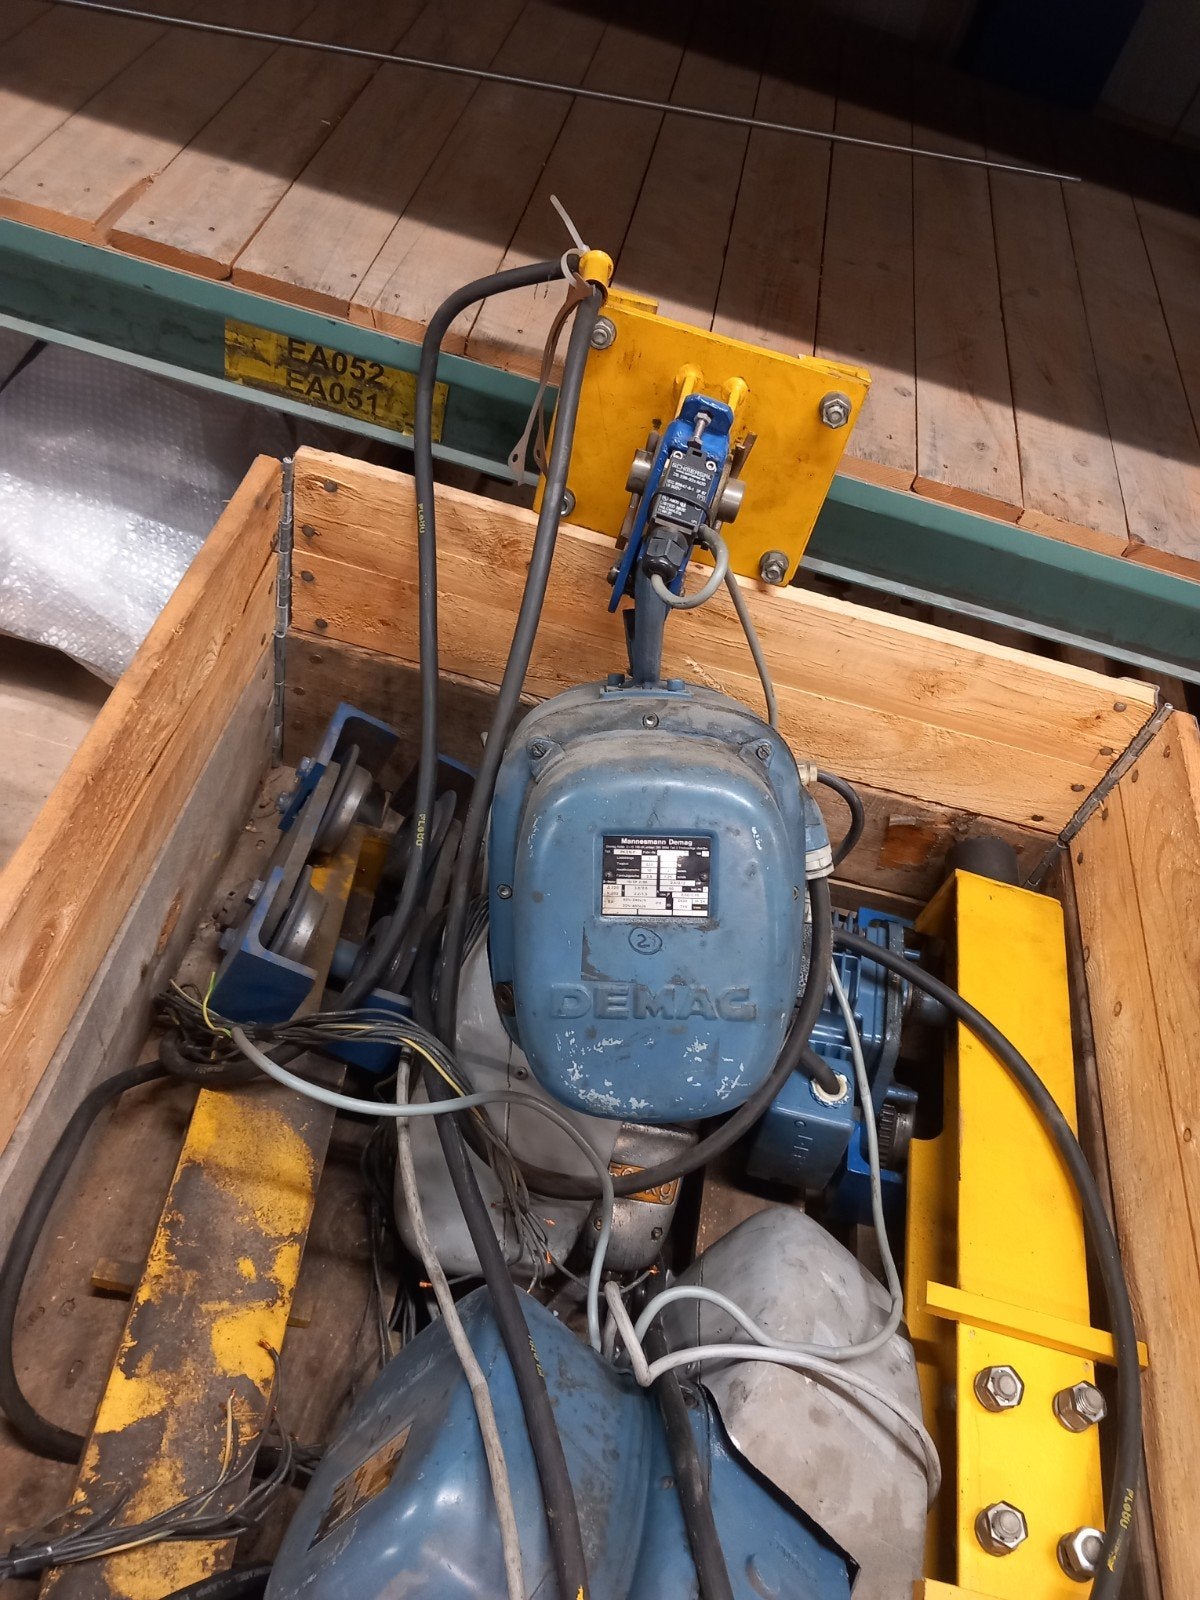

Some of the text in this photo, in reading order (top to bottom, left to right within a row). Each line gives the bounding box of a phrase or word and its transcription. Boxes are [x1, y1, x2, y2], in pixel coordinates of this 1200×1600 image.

[286, 338, 385, 386] EA052
[286, 370, 379, 417] EA051
[621, 837, 693, 847] Mannesmann Demag
[551, 982, 758, 1021] DEMAG
